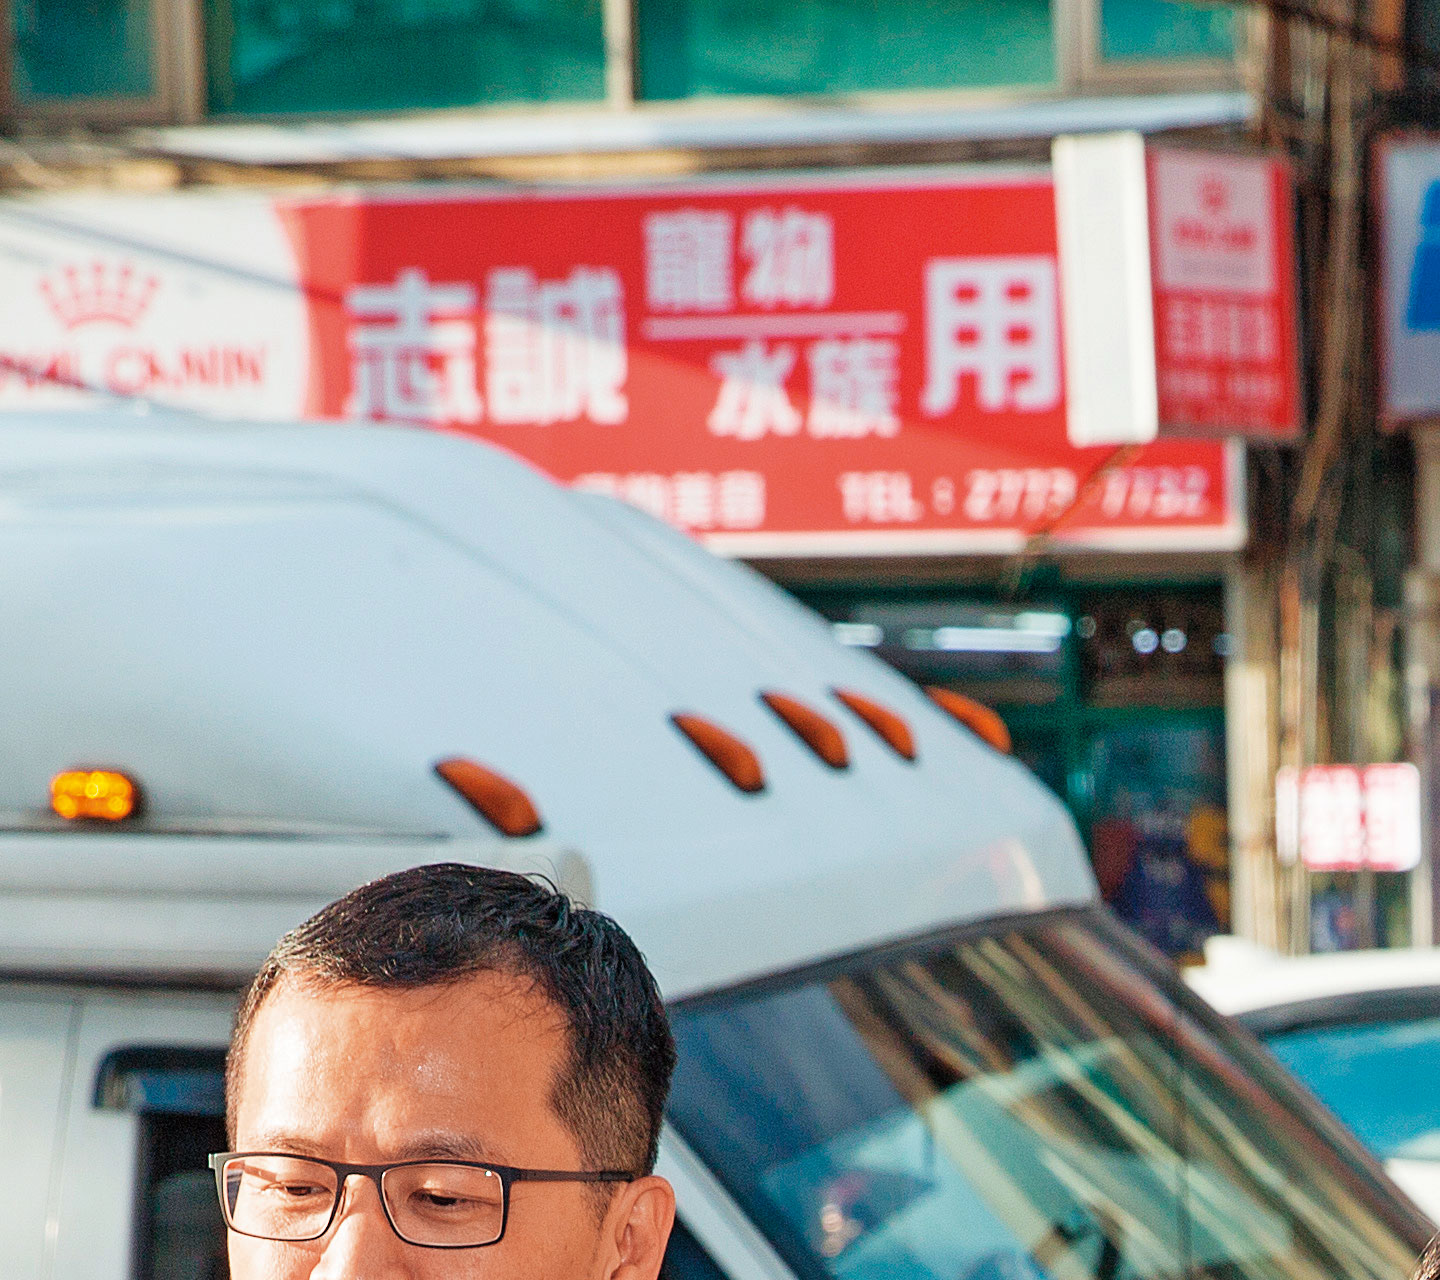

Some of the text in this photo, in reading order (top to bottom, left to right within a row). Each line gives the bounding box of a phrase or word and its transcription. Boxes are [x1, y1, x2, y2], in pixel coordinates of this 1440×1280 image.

[344, 266, 628, 424] 志誠
[709, 336, 901, 438] 水族
[922, 256, 1060, 416] 用
